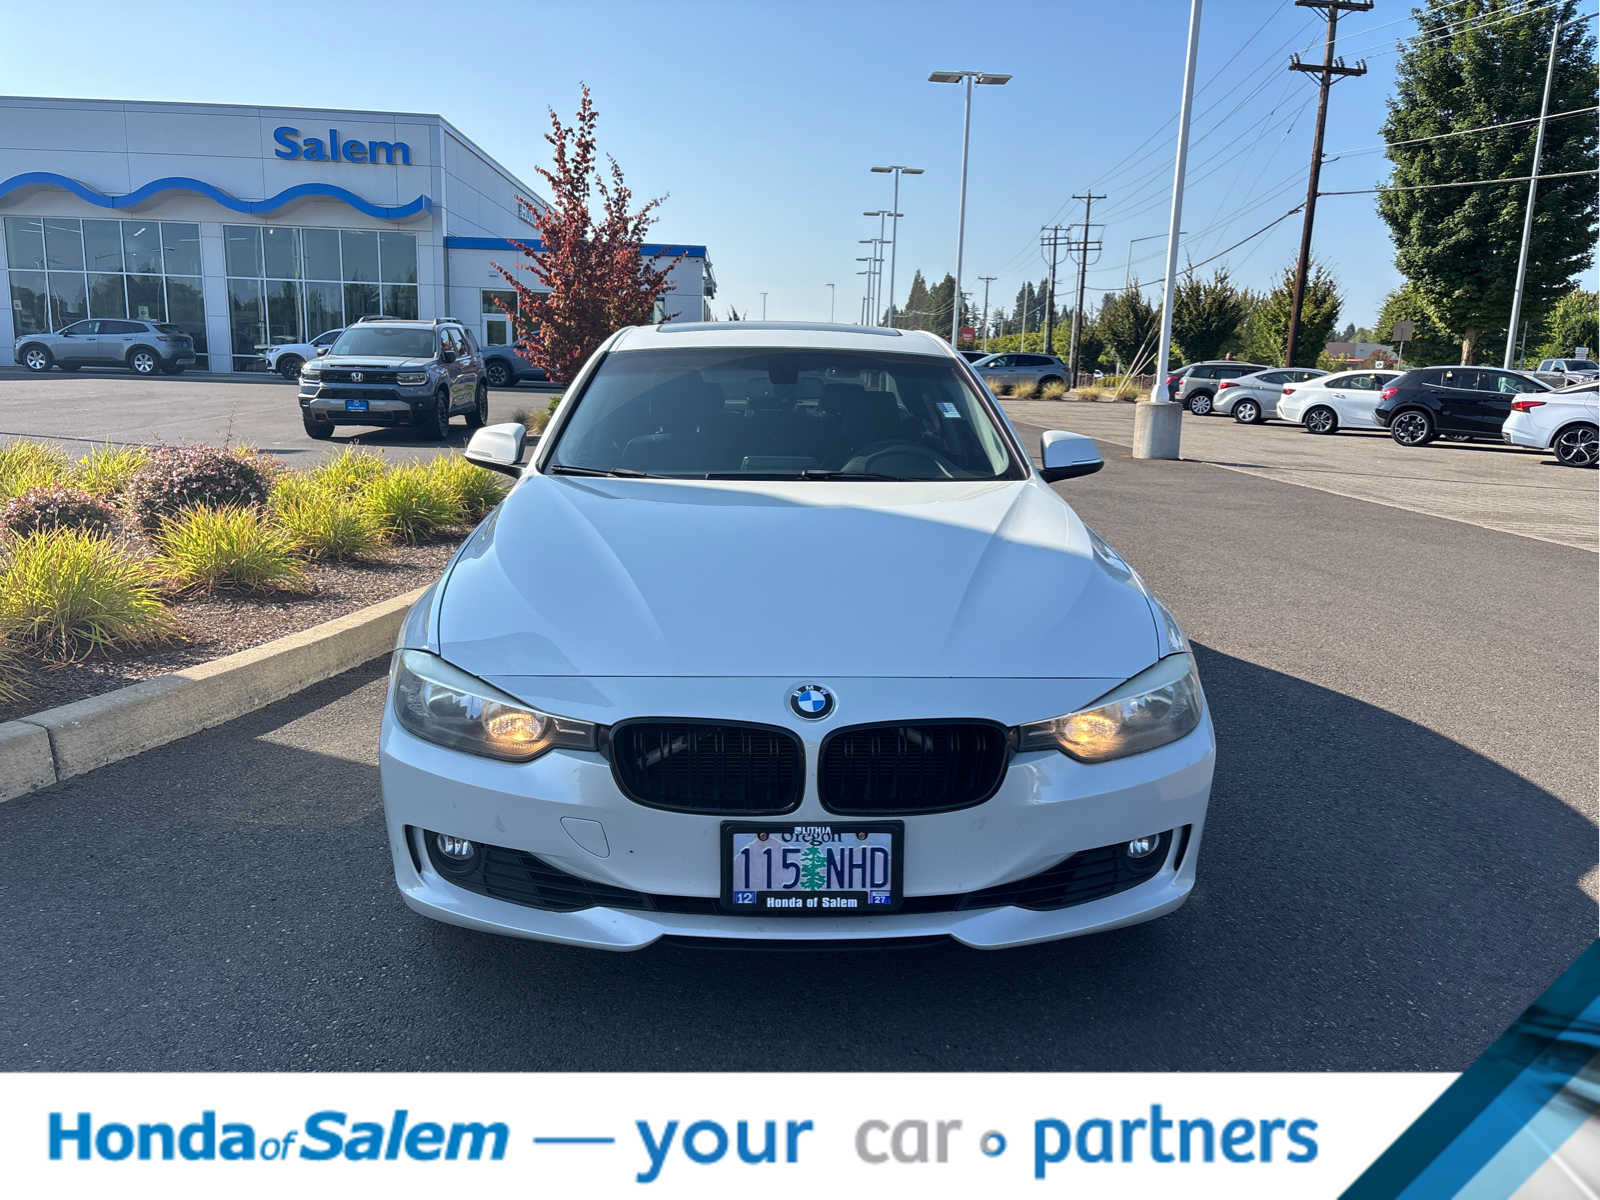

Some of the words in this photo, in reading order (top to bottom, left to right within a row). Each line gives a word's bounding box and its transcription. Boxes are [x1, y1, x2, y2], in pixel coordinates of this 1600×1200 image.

[273, 127, 411, 165] Salem
[741, 847, 801, 889] 115
[826, 847, 889, 889] NHD
[737, 892, 752, 904] 12
[766, 897, 802, 908] Honda
[806, 897, 819, 908] of
[822, 897, 858, 908] Salem
[874, 896, 886, 904] 27
